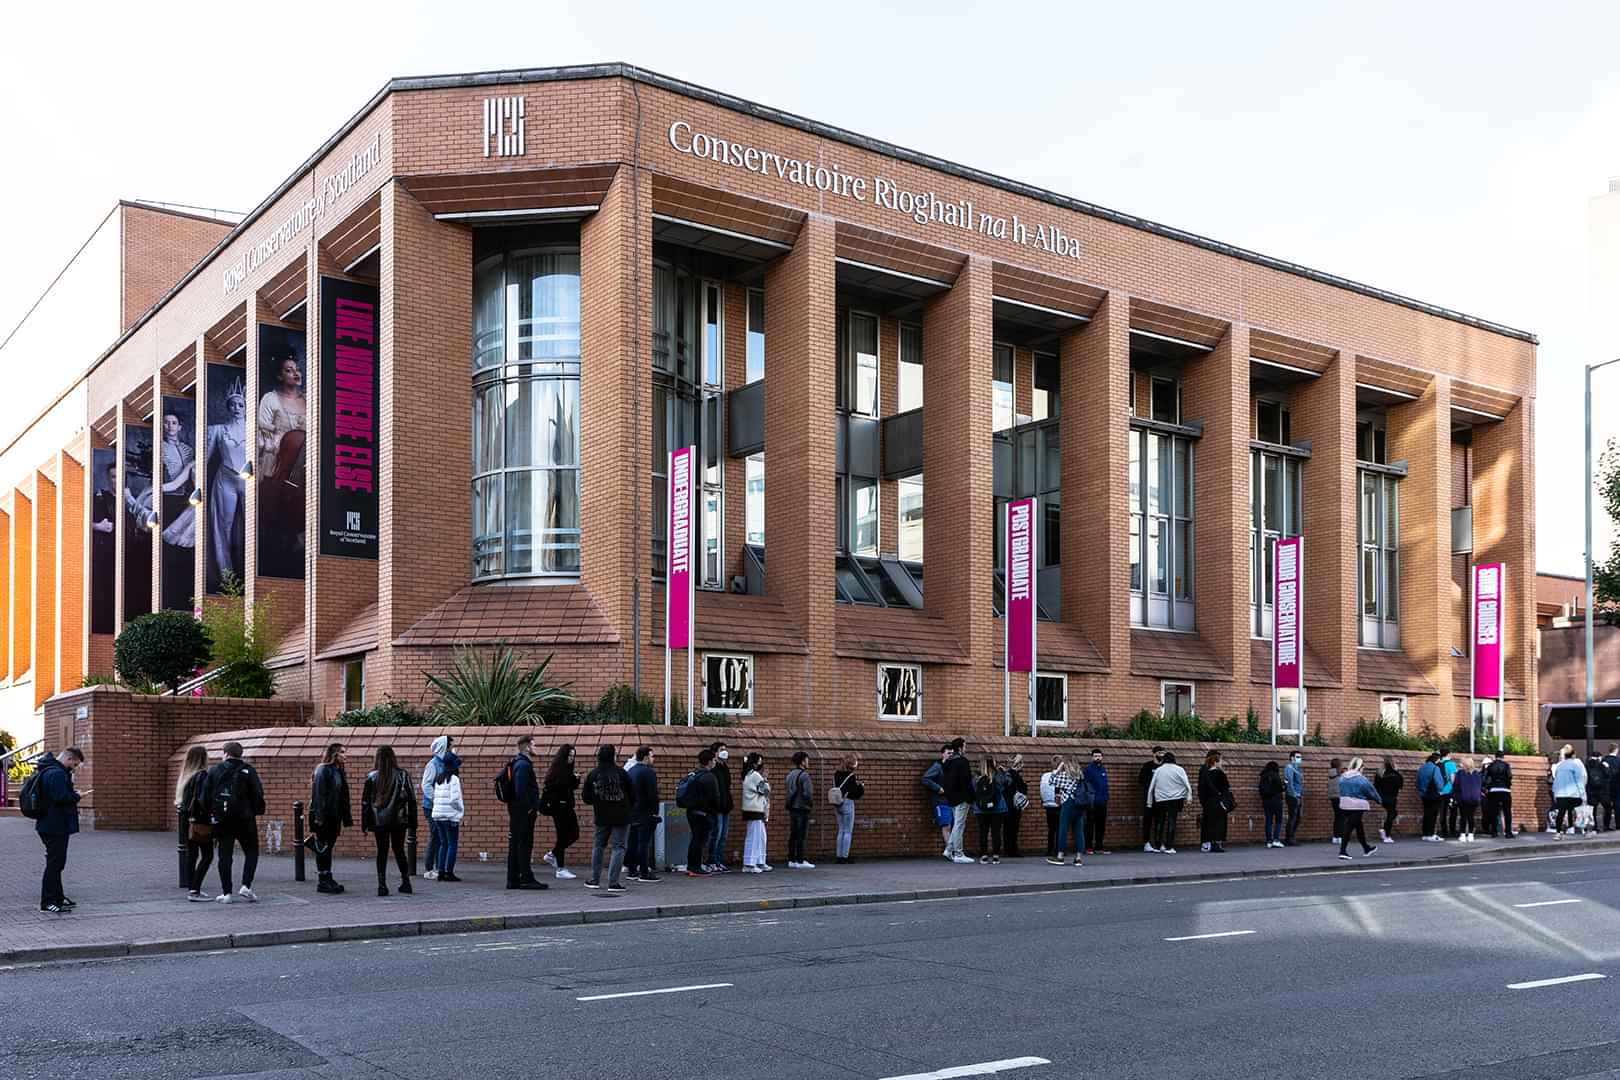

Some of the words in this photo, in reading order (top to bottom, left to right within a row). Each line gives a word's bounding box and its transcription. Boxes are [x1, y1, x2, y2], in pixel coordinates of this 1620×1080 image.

[223, 254, 248, 295] Royal
[249, 198, 317, 271] Conservatoire
[317, 177, 331, 218] of
[329, 132, 381, 205] Scotland
[668, 121, 866, 200] Conservatoire
[873, 177, 974, 230] Rìoghail
[979, 212, 1006, 239] na
[1012, 216, 1080, 259] h-Alba
[336, 297, 373, 344] LIKE
[336, 344, 373, 442] NOWHERE
[336, 444, 373, 494] ELSE
[672, 453, 689, 575] UNDERGRADUATE
[1011, 504, 1029, 600] POSTGRADUATE
[1279, 544, 1296, 581] JUNIOR
[1279, 582, 1296, 666] CONSERVATOIRE
